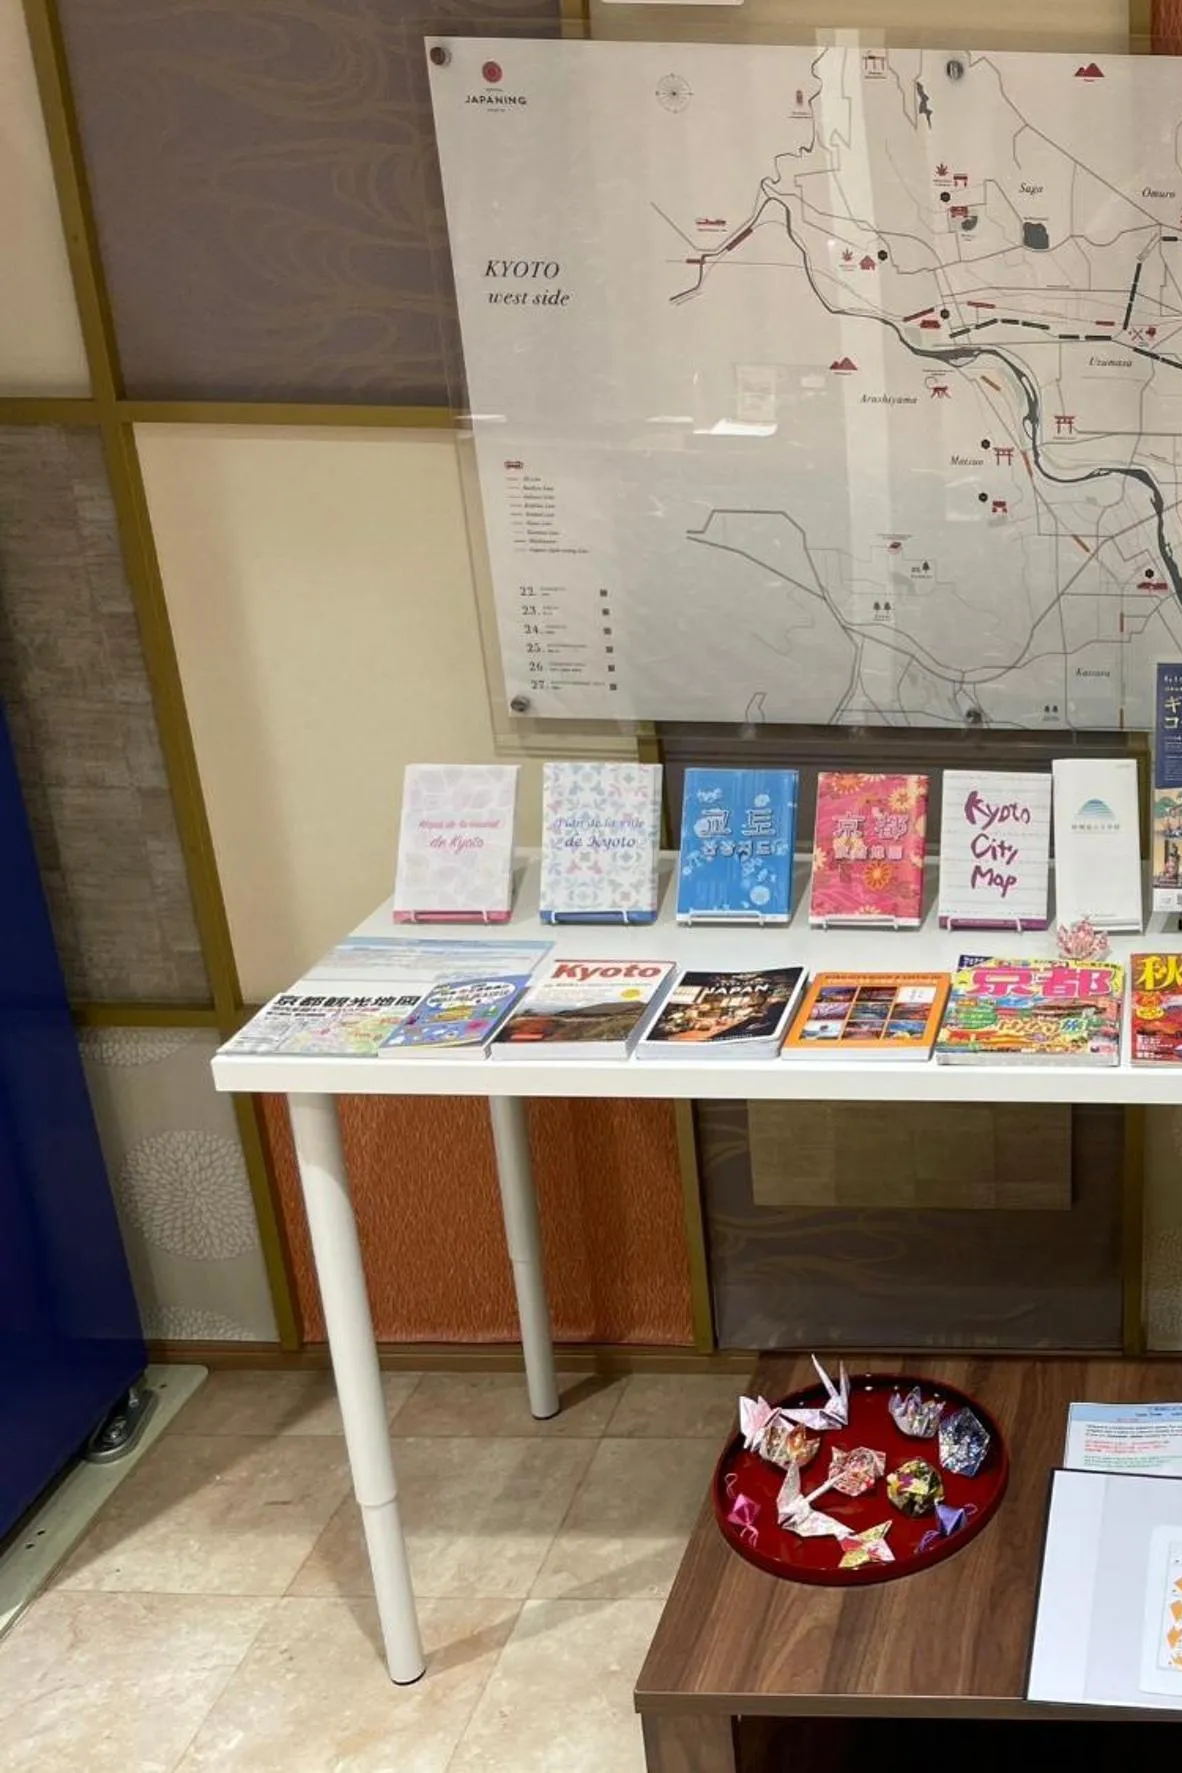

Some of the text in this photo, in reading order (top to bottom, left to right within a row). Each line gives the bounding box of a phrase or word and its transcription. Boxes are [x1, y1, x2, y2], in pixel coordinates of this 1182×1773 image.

[464, 95, 527, 104] JAPANING
[1018, 182, 1044, 195] Saga
[1142, 187, 1176, 199] Omuro
[485, 259, 560, 279] KYOTO
[488, 289, 569, 306] west side
[965, 790, 1031, 830] Kyoto
[832, 811, 909, 840] 京都
[564, 835, 636, 851] de Kyoto
[970, 833, 1019, 865] City
[971, 865, 1017, 898] Map
[552, 964, 662, 981] Kyoto
[705, 983, 769, 997] JAPAN
[965, 965, 1114, 1000] 京都
